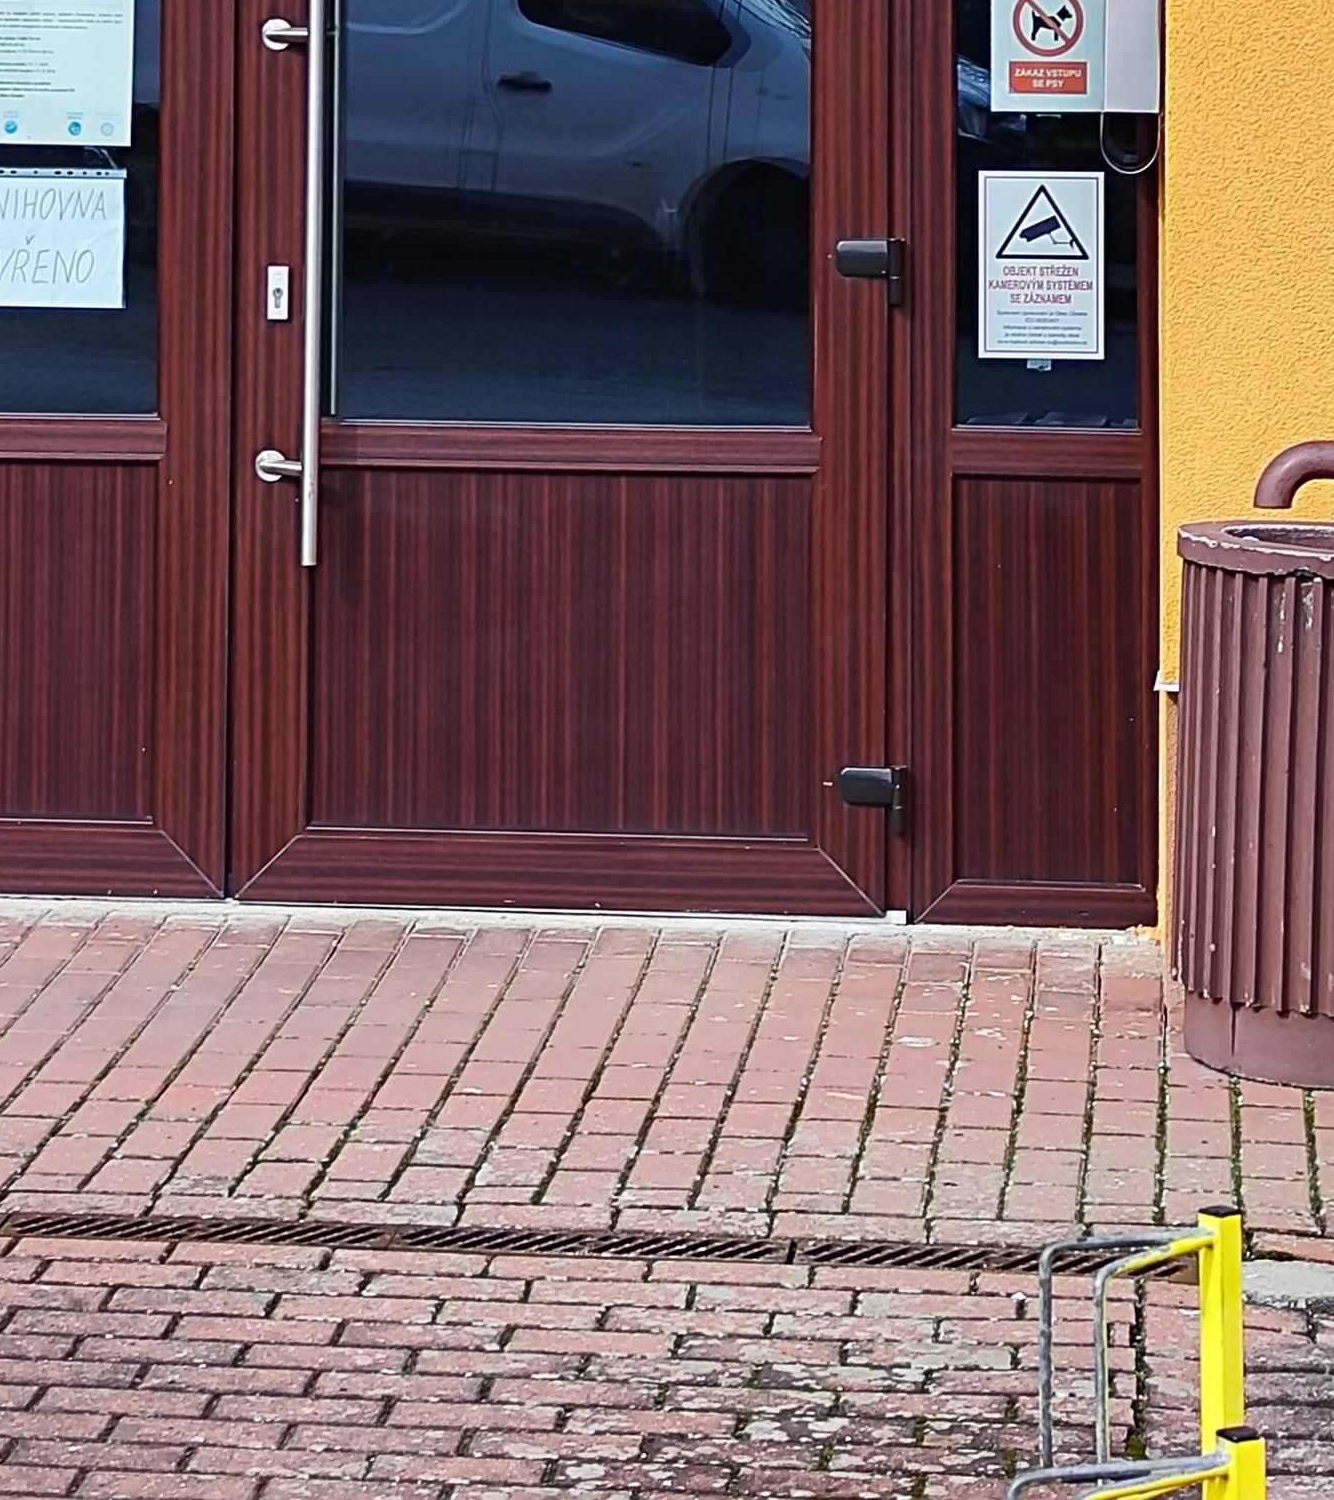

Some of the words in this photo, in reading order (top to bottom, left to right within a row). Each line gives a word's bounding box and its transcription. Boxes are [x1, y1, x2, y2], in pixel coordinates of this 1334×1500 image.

[1014, 66, 1045, 77] ZÁKAZ
[1046, 68, 1082, 78] VSTUPU
[1032, 79, 1046, 88] SE
[1047, 79, 1065, 88] PSY
[1003, 265, 1038, 278] OBJEKT
[1039, 264, 1079, 277] STŘEŽEN
[988, 278, 1044, 290] KAMEROVÝM
[1045, 278, 1094, 291] SYSTÉMEM
[1010, 294, 1022, 304] SE
[1023, 293, 1072, 305] ZÁZNAMEM
